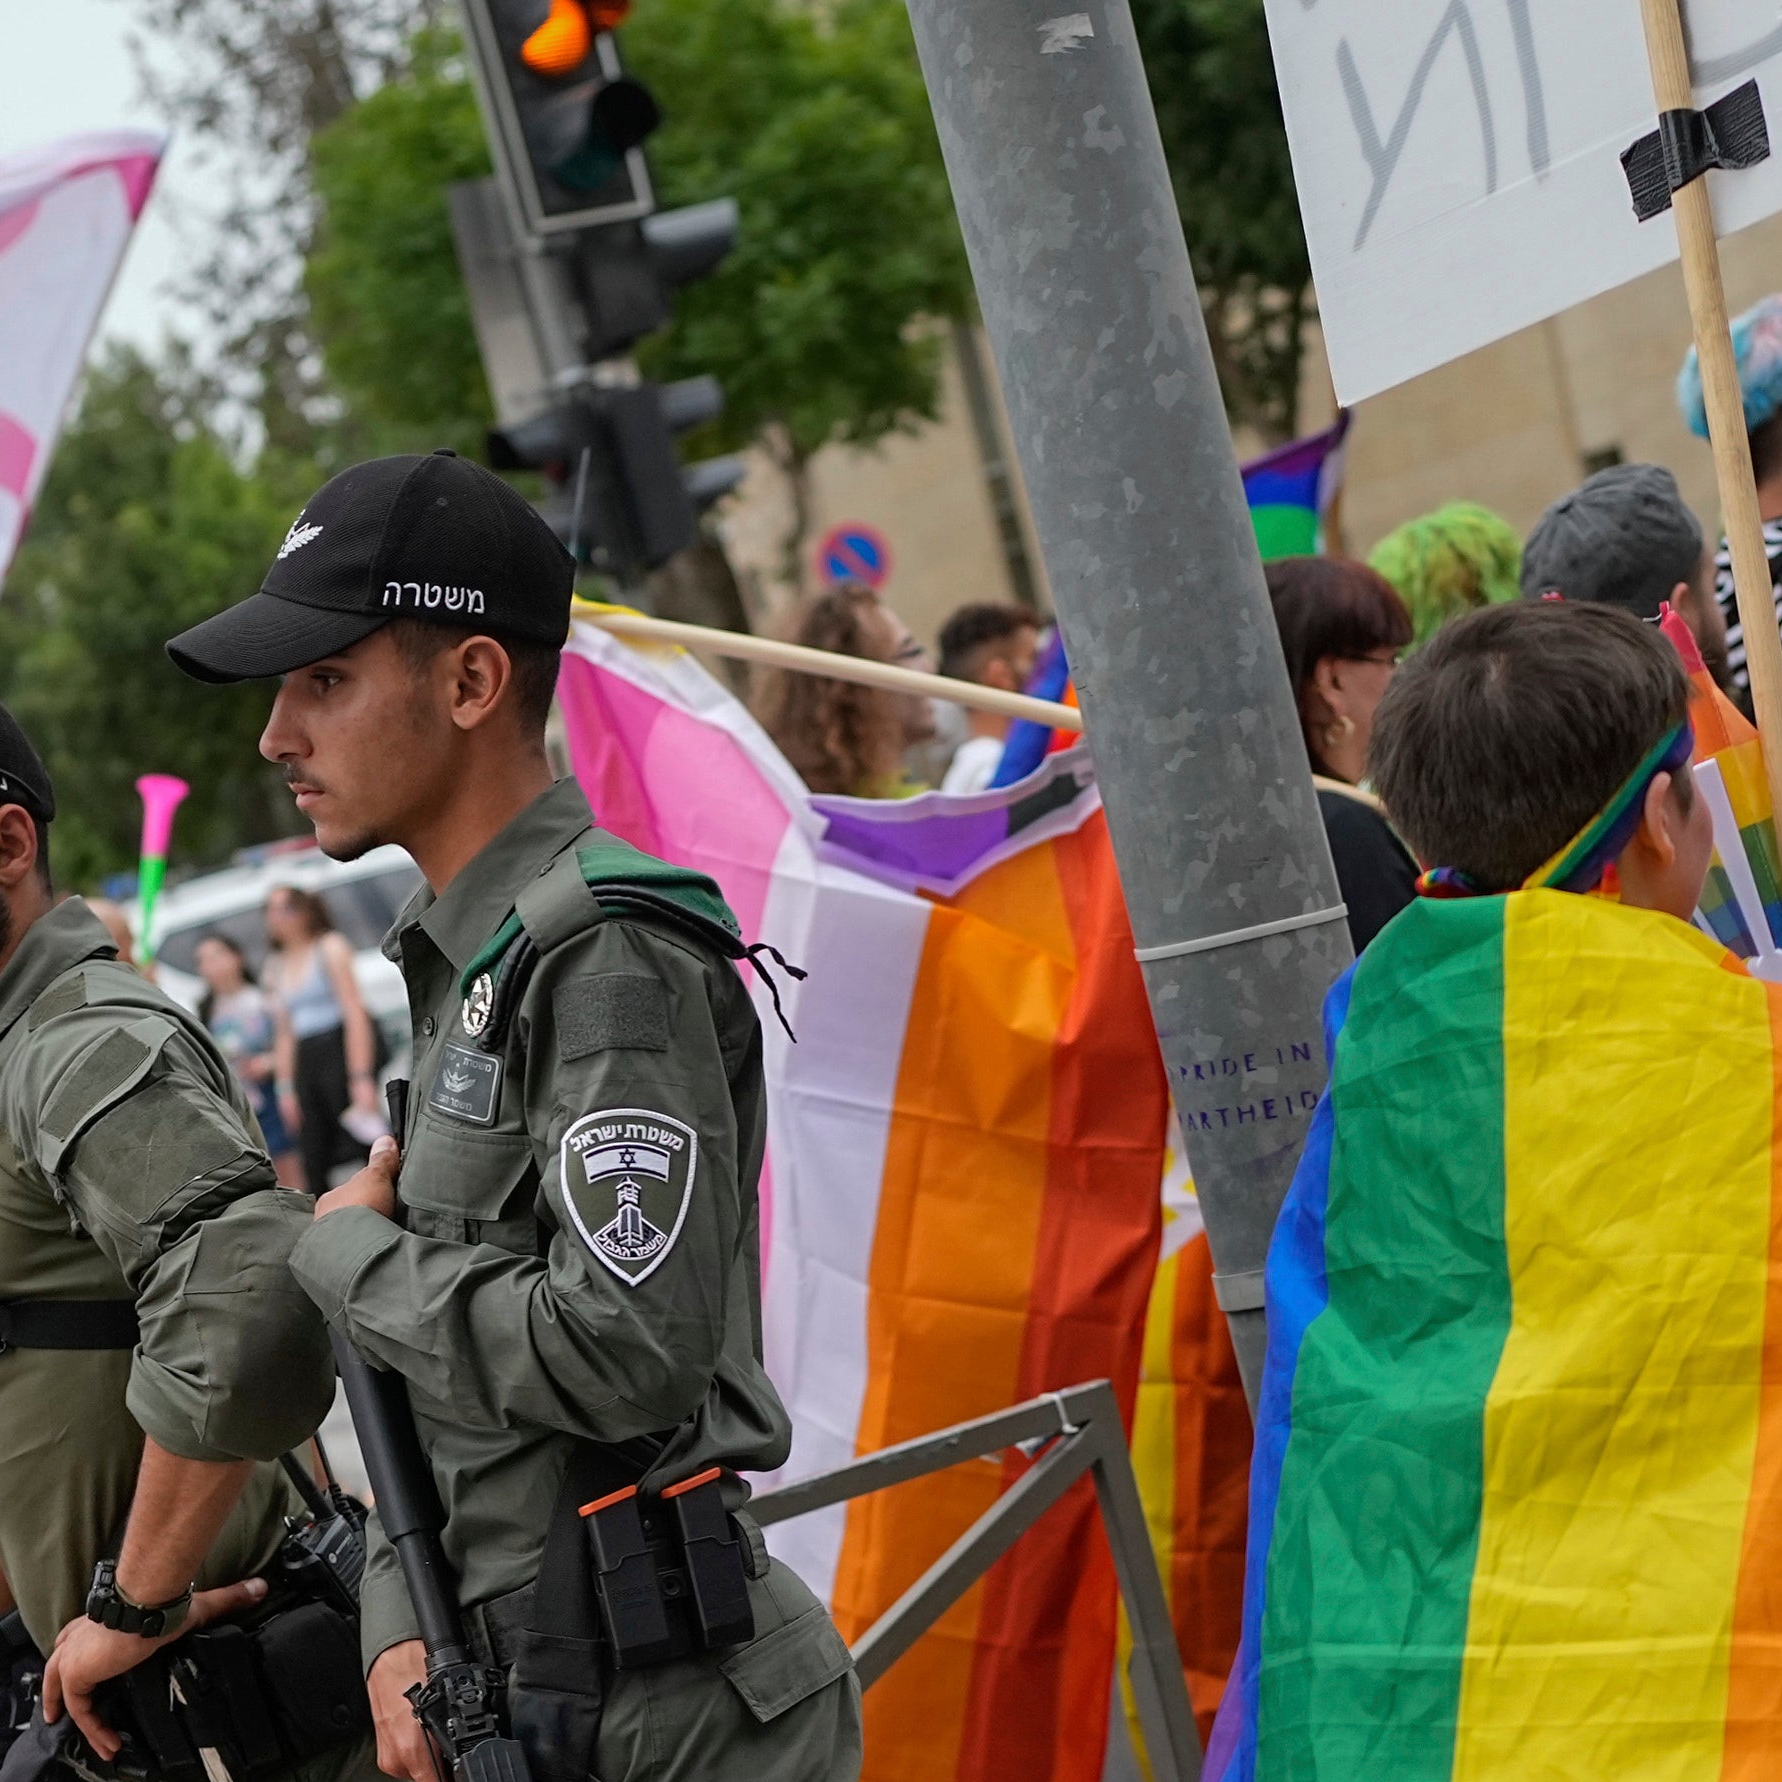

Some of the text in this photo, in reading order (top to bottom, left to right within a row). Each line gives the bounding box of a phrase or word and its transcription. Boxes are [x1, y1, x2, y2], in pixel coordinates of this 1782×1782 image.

[382, 581, 485, 614] משטרה
[1179, 1042, 1311, 1082] PRIDE IN
[1179, 1090, 1319, 1132] ARTHEID
[569, 1123, 685, 1152] משטרת ישראל
[630, 1234, 664, 1257] משמר
